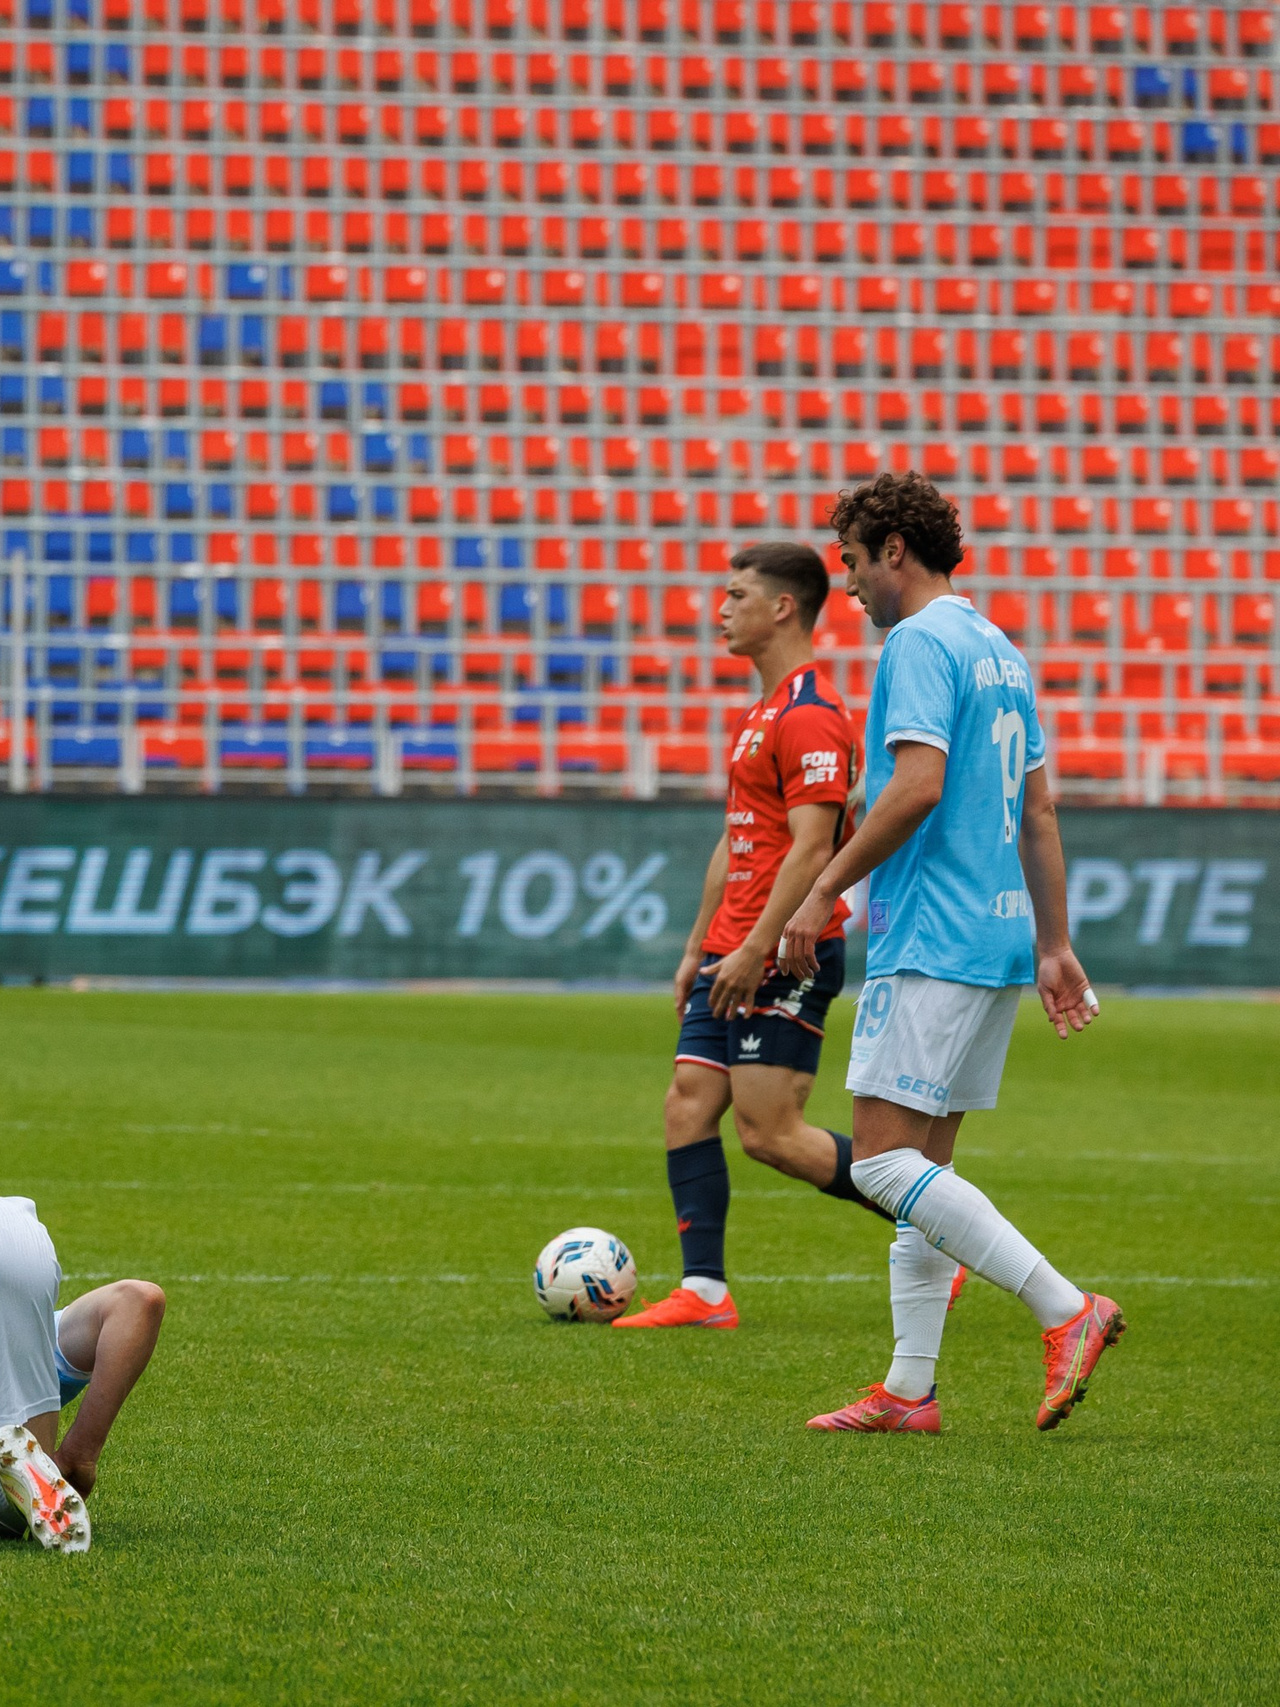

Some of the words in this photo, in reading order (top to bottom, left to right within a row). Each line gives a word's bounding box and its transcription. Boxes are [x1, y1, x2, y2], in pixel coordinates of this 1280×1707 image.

[801, 751, 837, 769] FON
[804, 766, 838, 785] BET
[456, 849, 669, 941] 10%
[854, 981, 893, 1039] 19
